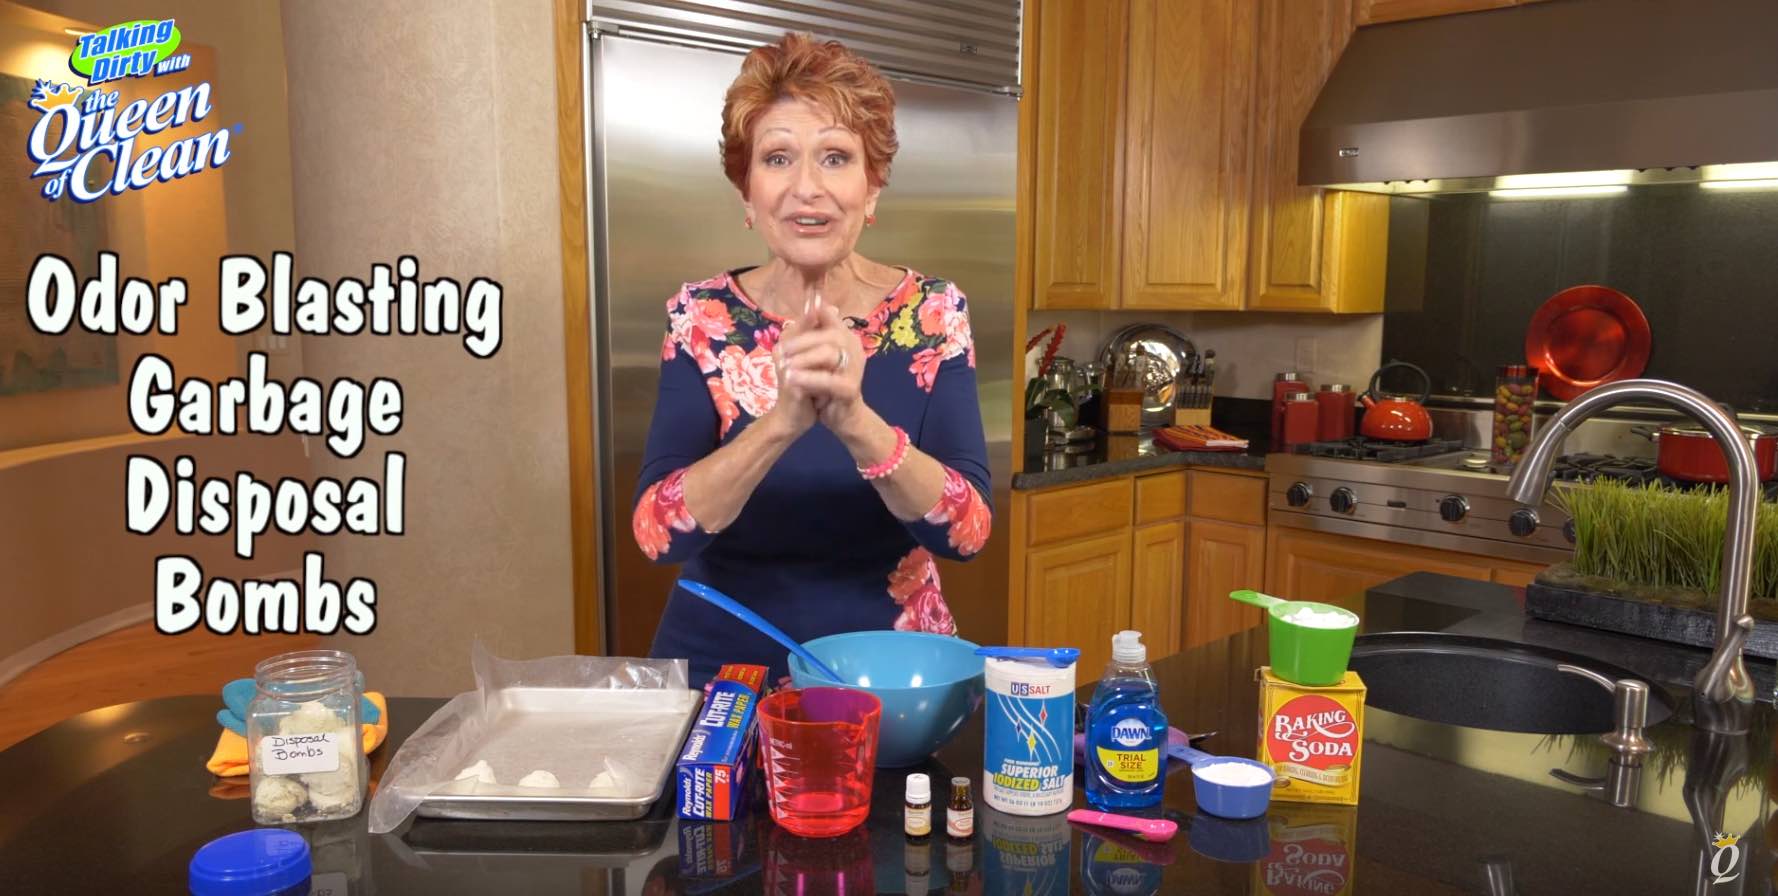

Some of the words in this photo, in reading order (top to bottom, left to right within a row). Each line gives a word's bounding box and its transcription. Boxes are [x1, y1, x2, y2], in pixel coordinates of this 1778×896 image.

[733, 693, 750, 714] PAPER
[726, 714, 741, 729] WAX
[1275, 710, 1355, 741] BAKING
[271, 733, 330, 748] Disposal
[1111, 726, 1151, 741] DAWN
[271, 746, 323, 761] Bombs
[682, 733, 707, 761] Reynolds
[1289, 739, 1353, 762] SODA
[1117, 753, 1147, 762] TRIAL
[1120, 761, 1142, 770] SIZE
[715, 769, 727, 784] 75
[1001, 763, 1058, 779] SUPERIOR
[705, 772, 713, 799] PAPER
[993, 773, 1040, 791] IODIZED
[1041, 775, 1065, 791] SALT
[682, 777, 693, 816] Reynolds
[705, 800, 713, 818] WAX
